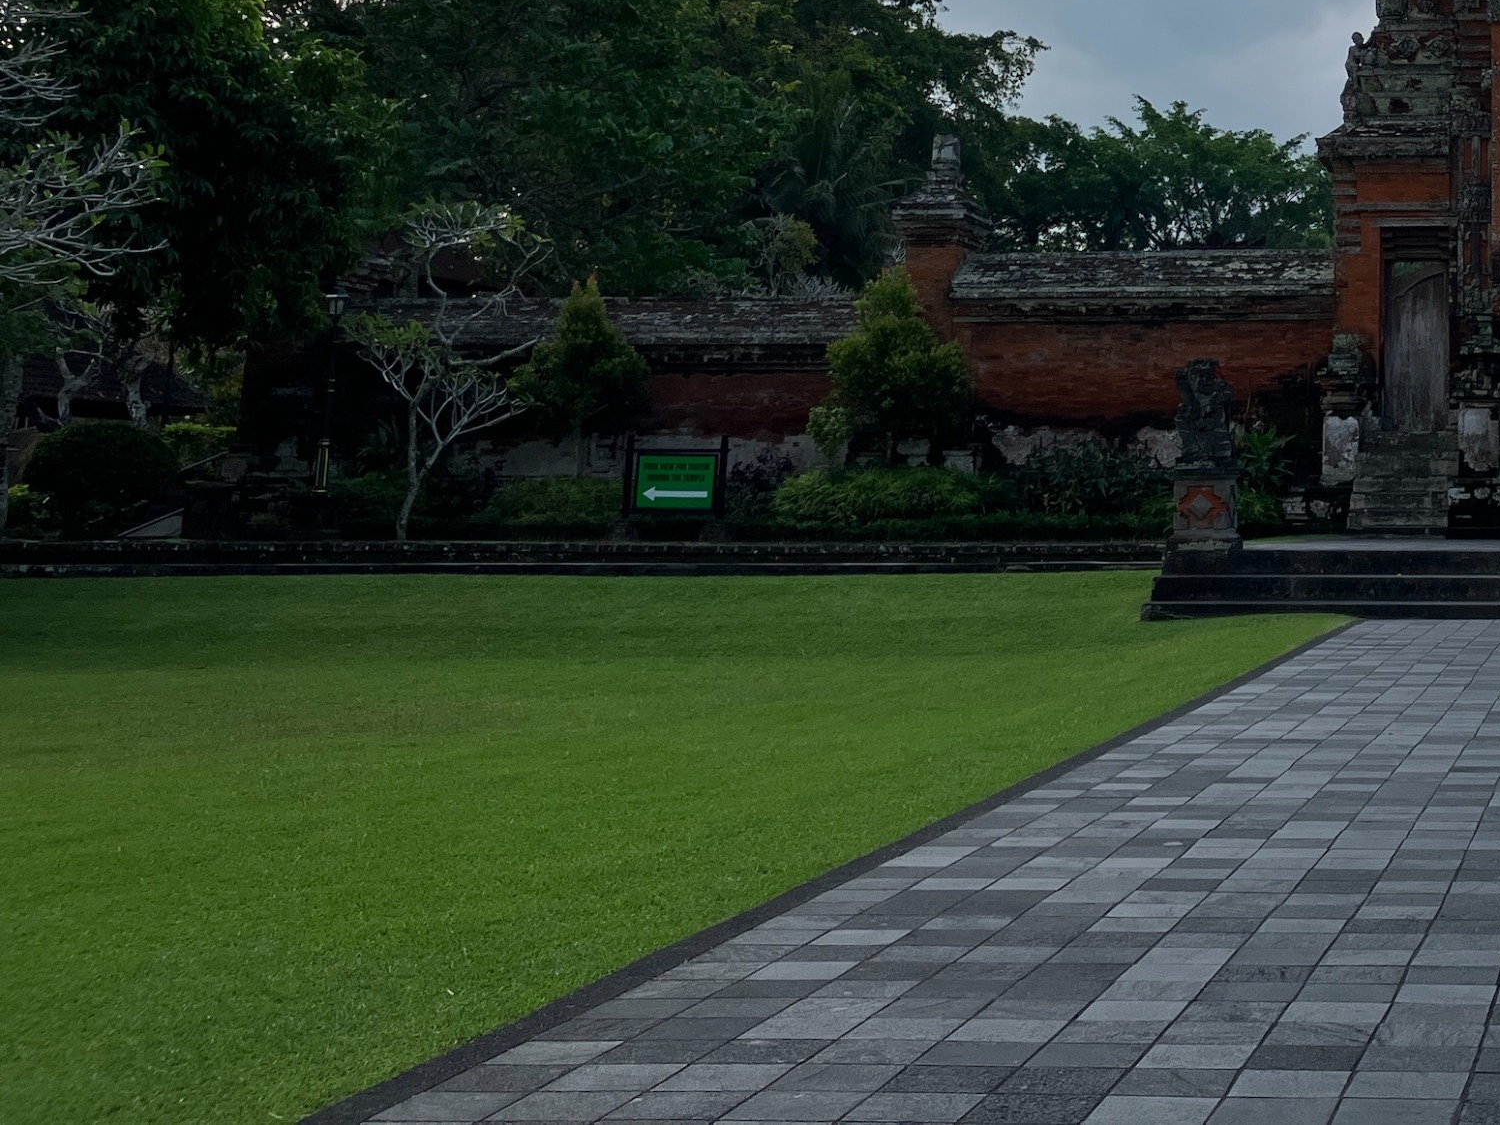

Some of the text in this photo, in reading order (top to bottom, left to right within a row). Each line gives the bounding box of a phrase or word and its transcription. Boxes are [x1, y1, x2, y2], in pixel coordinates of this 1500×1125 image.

[660, 463, 674, 471] VIEW
[676, 463, 687, 471] FOR
[671, 474, 682, 482] THE
[683, 474, 705, 482] TEMPLE
